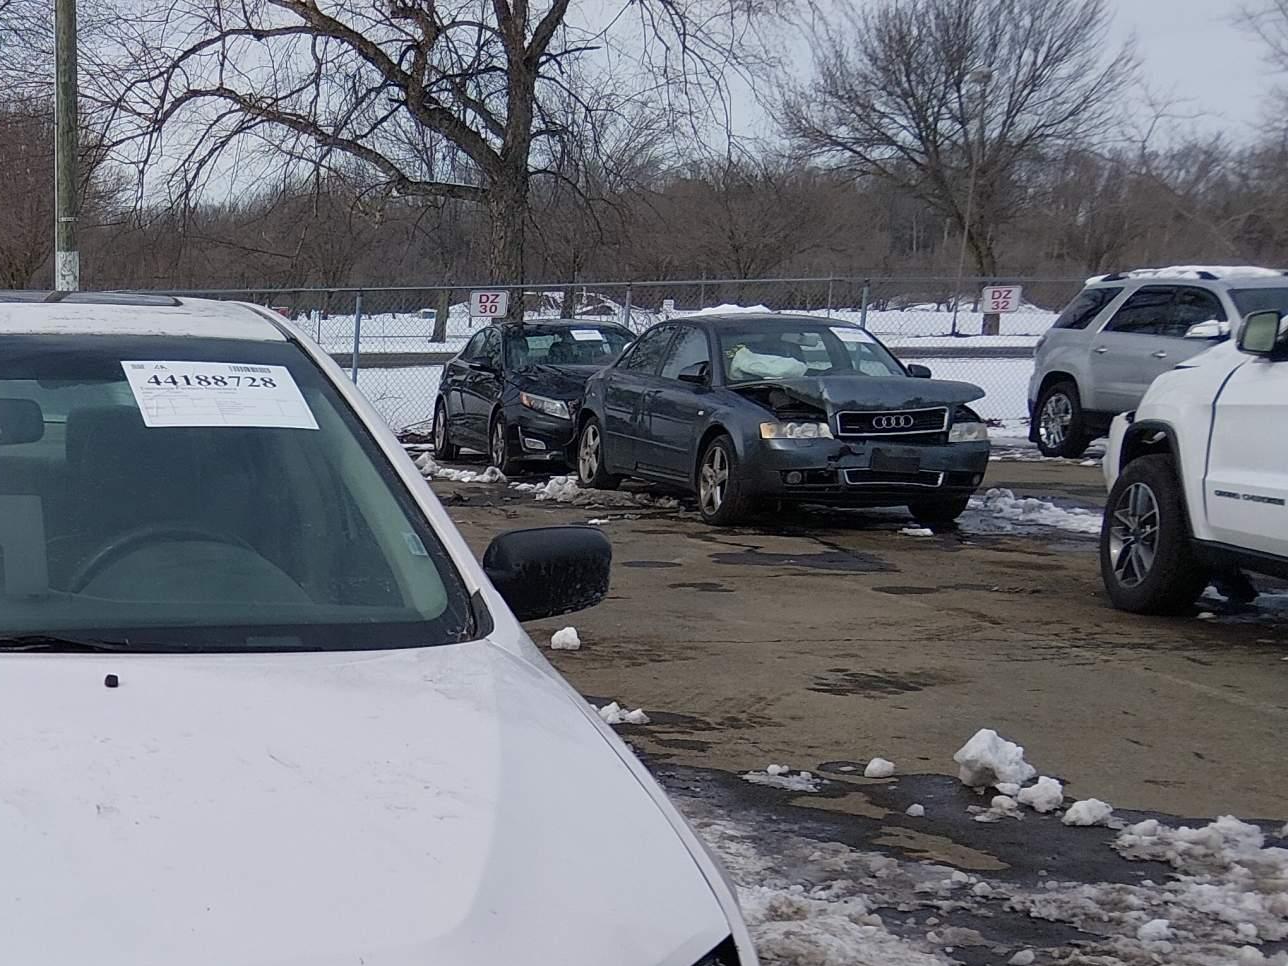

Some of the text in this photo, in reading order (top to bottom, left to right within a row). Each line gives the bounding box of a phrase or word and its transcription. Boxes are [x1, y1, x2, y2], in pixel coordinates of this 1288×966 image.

[479, 294, 500, 304] DZ
[992, 290, 1013, 300] DZ
[479, 304, 498, 314] 30
[992, 301, 1009, 310] 32
[147, 374, 277, 388] 44188728
